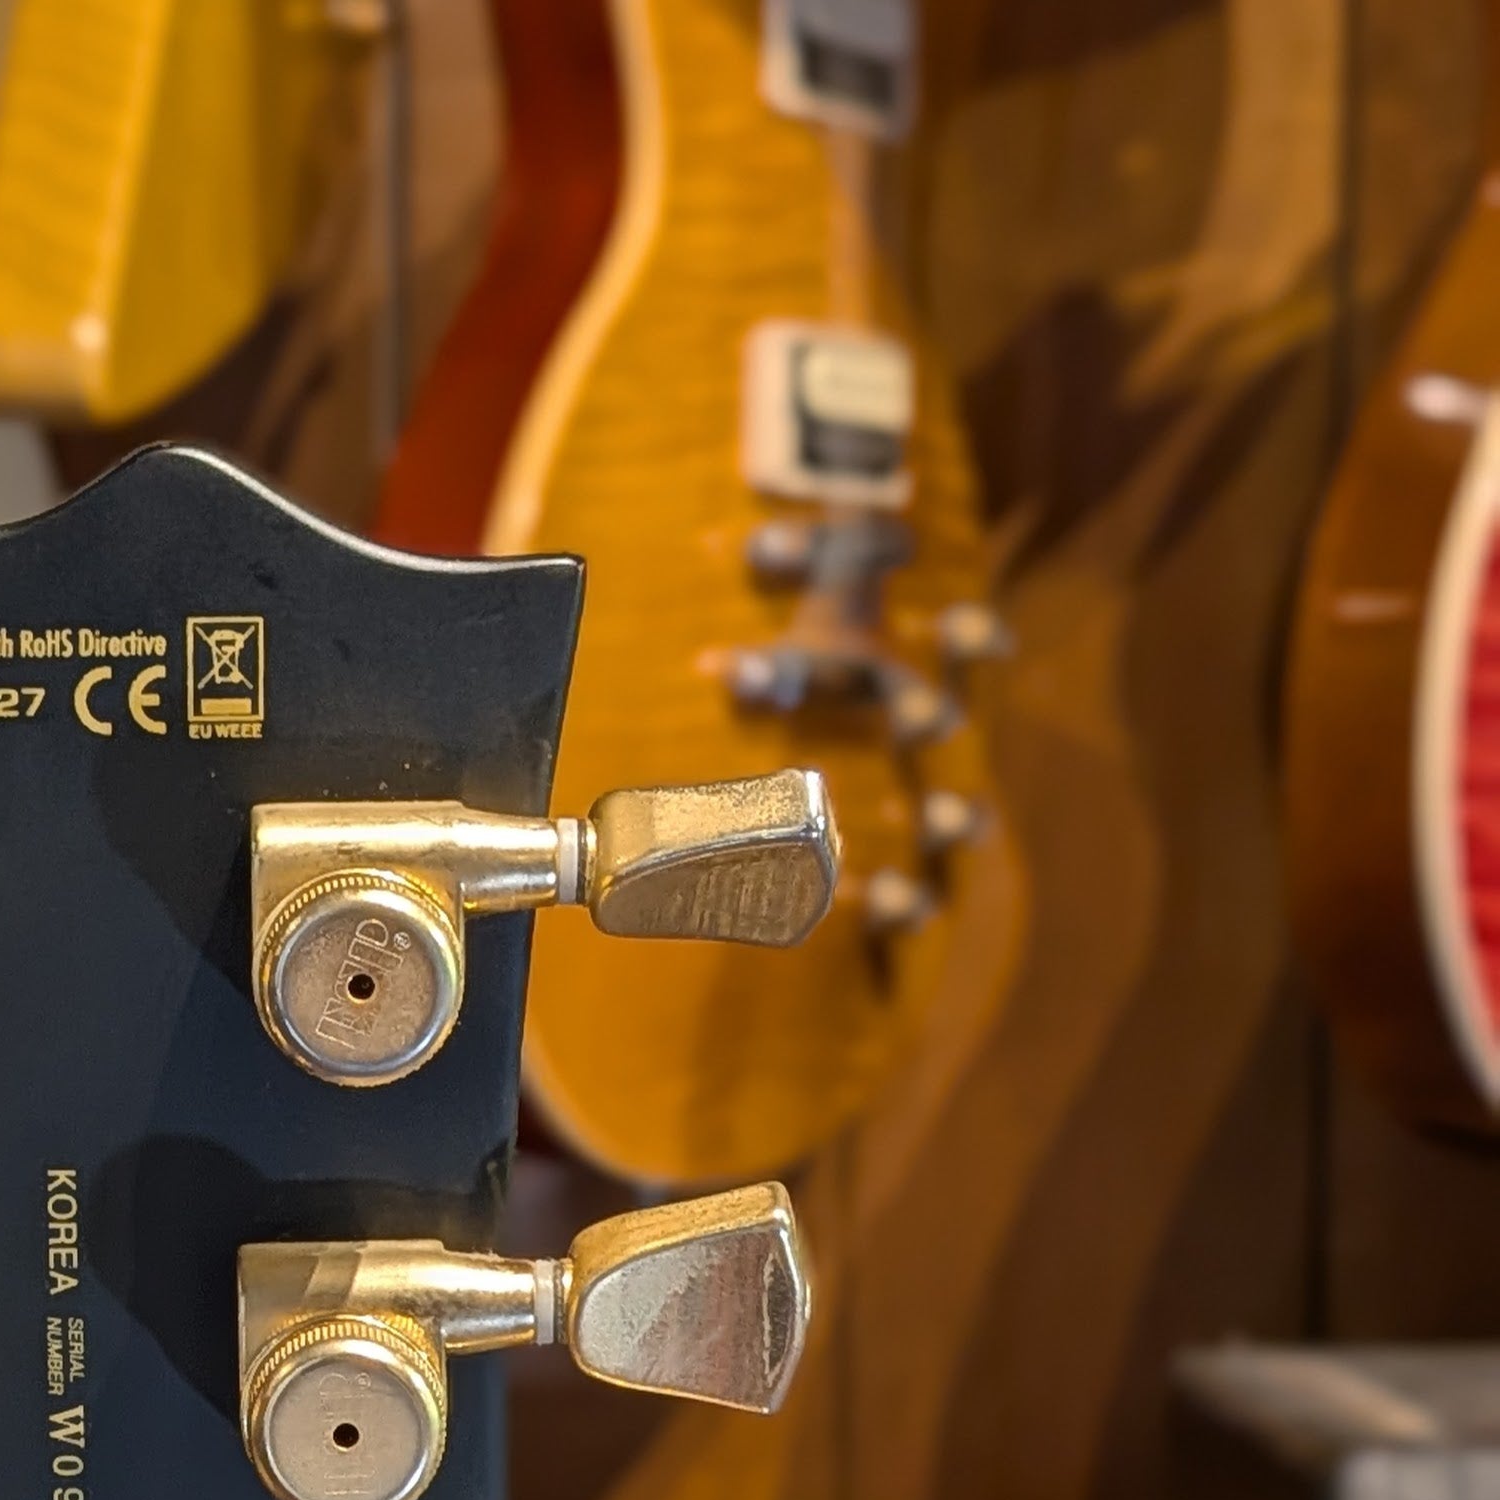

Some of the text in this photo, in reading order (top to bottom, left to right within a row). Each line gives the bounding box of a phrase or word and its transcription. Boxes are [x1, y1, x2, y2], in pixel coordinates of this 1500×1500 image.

[19, 627, 73, 659] RoHS
[78, 628, 167, 657] Directive
[73, 664, 167, 736] CE
[188, 722, 263, 739] EU WEEE
[47, 1169, 80, 1296] KOREA
[47, 1316, 65, 1396] NUMBER
[67, 1316, 85, 1382] SERIAL
